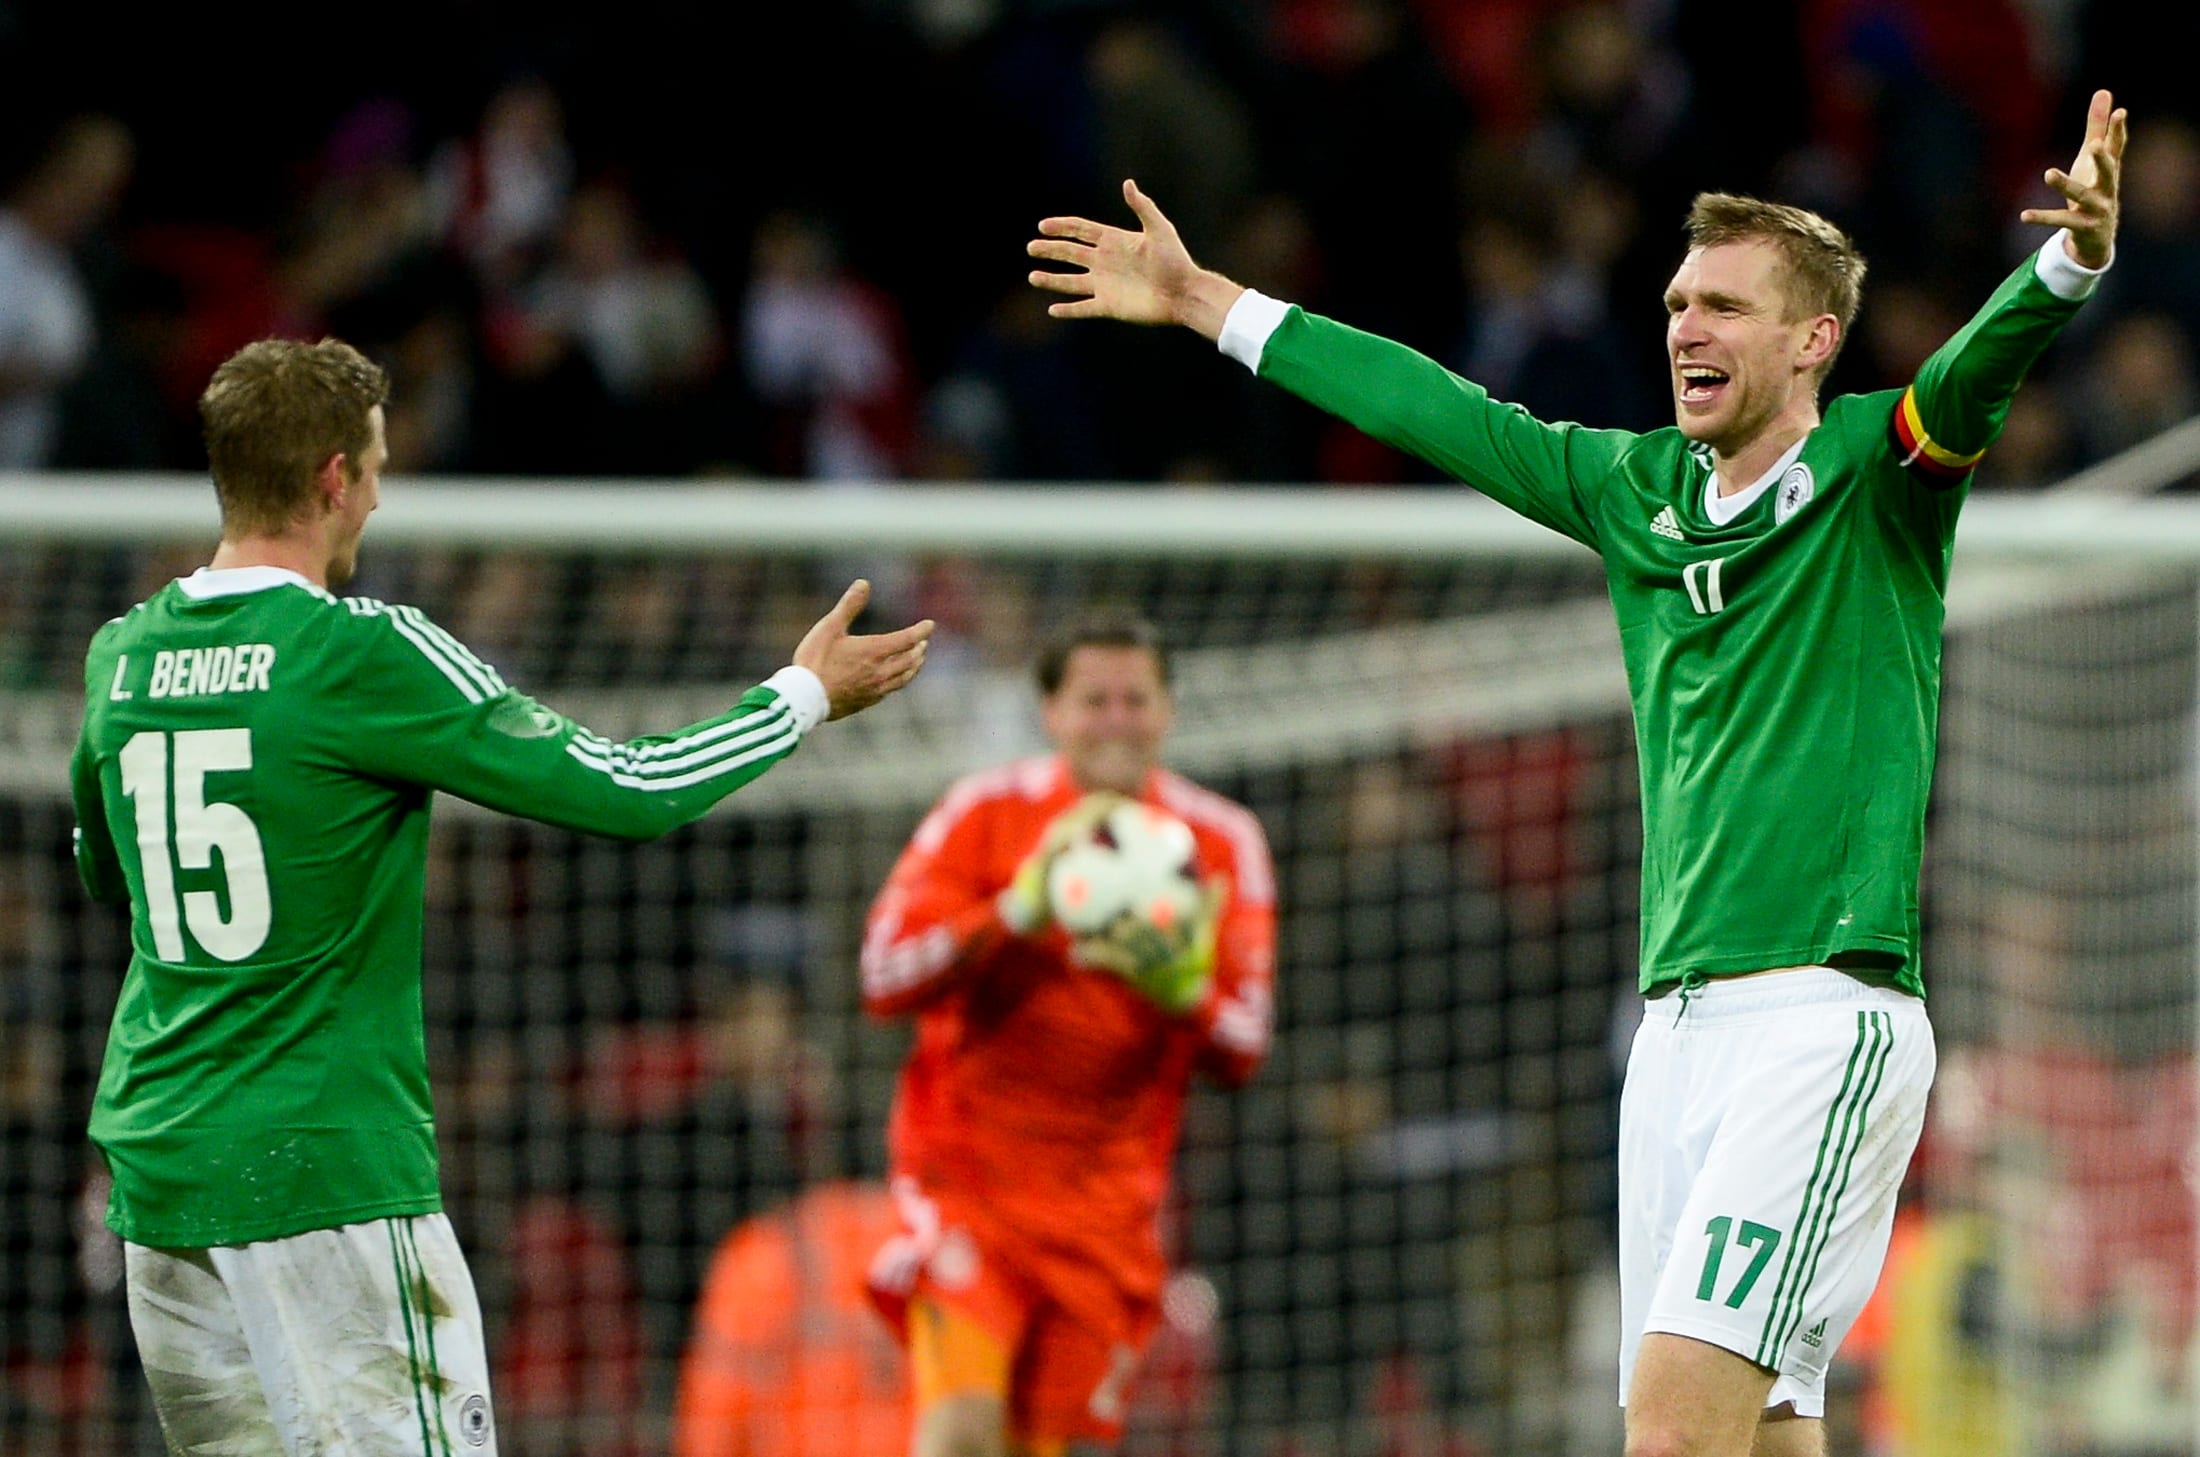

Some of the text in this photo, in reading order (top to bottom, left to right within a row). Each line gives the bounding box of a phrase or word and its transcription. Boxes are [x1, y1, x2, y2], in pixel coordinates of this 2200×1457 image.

[148, 644, 276, 699] BENDER
[119, 728, 272, 962] 15
[1696, 1216, 1782, 1309] 17
